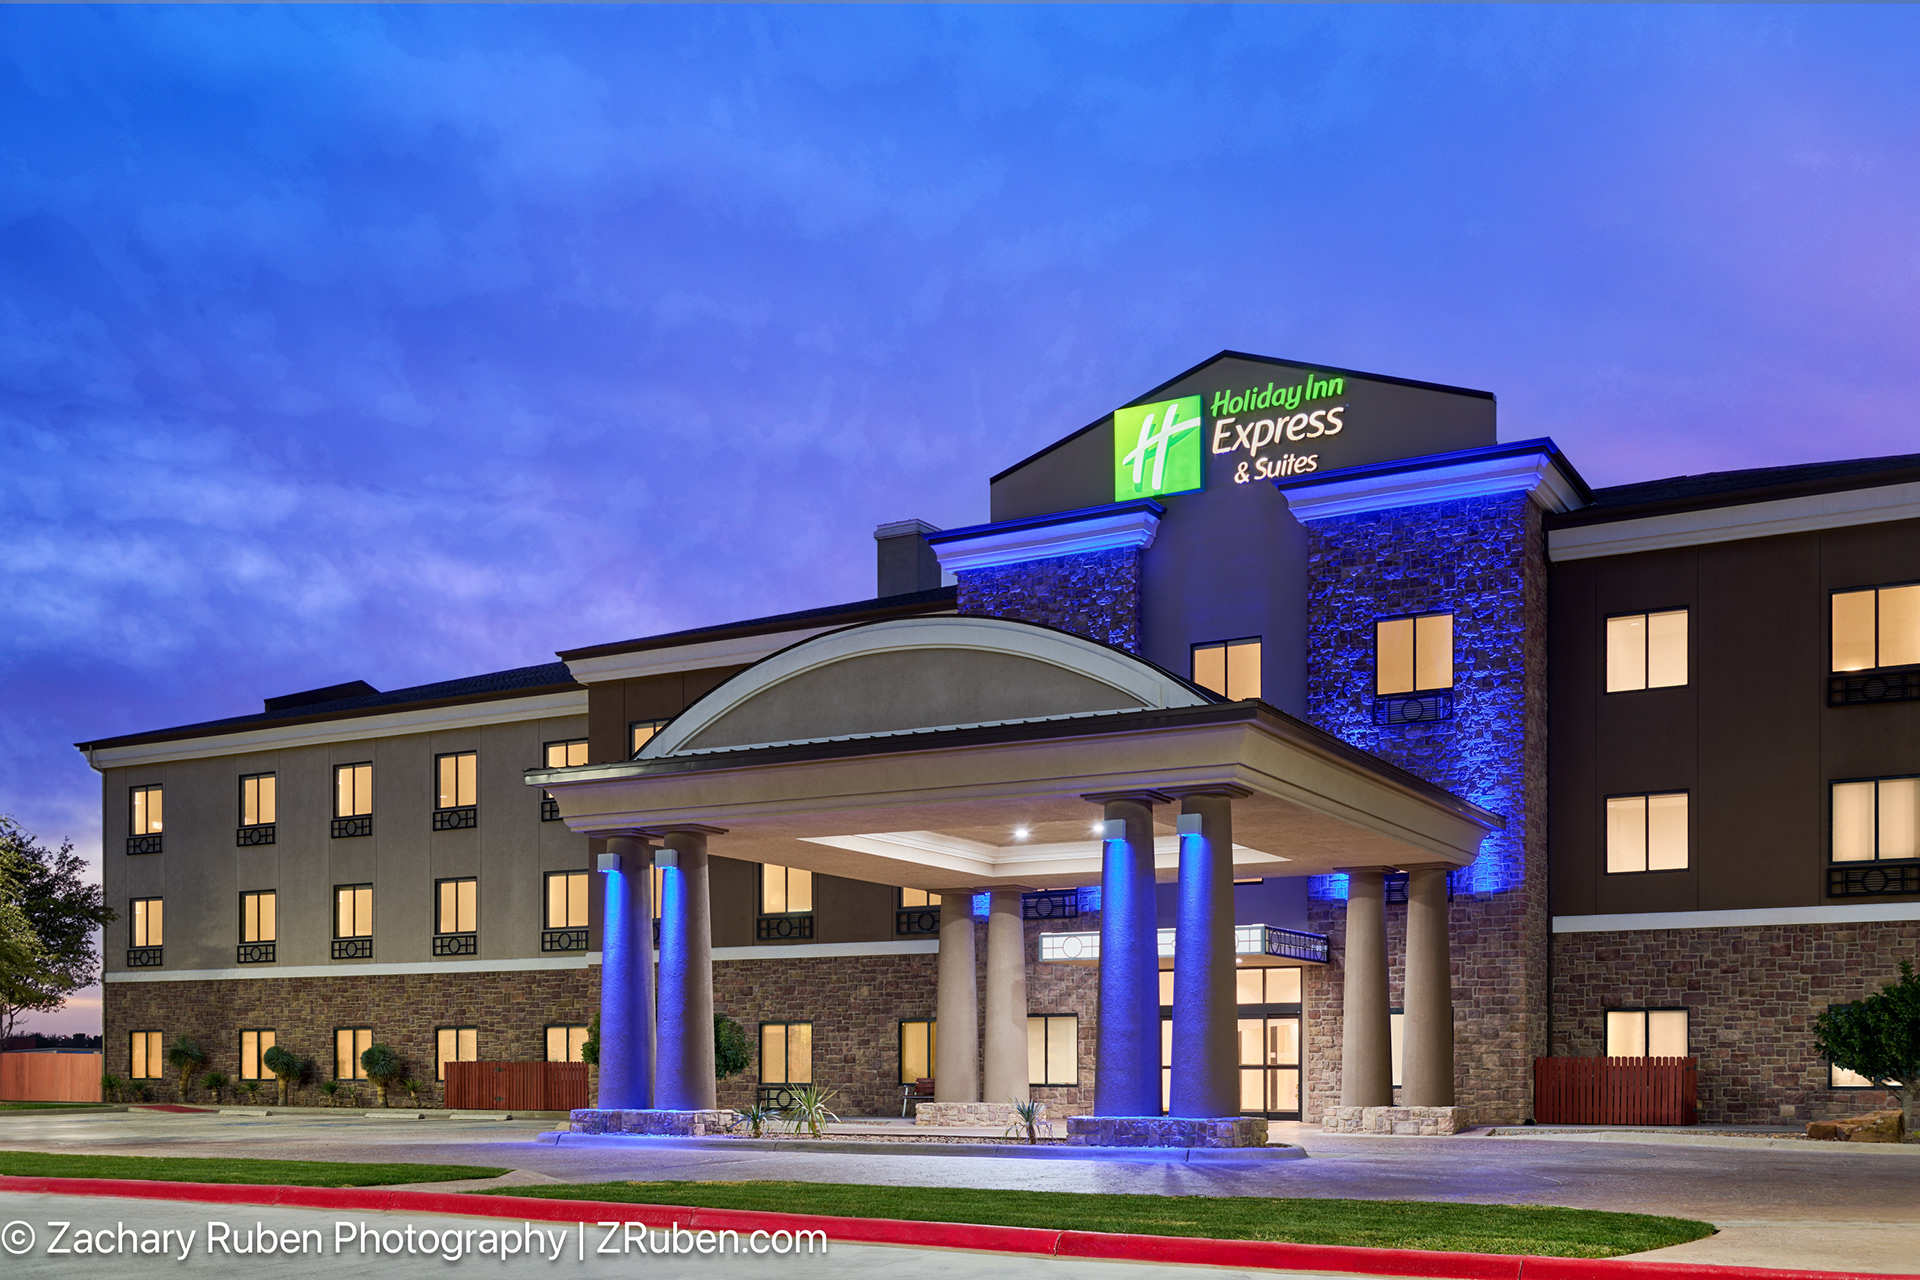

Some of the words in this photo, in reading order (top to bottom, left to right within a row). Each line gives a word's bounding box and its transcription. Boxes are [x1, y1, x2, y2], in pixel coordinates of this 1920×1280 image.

[1210, 382, 1302, 417] Holiday
[1305, 374, 1344, 401] Inn
[1211, 406, 1345, 457] Express
[1234, 461, 1250, 484] &
[1254, 454, 1319, 480] Suites
